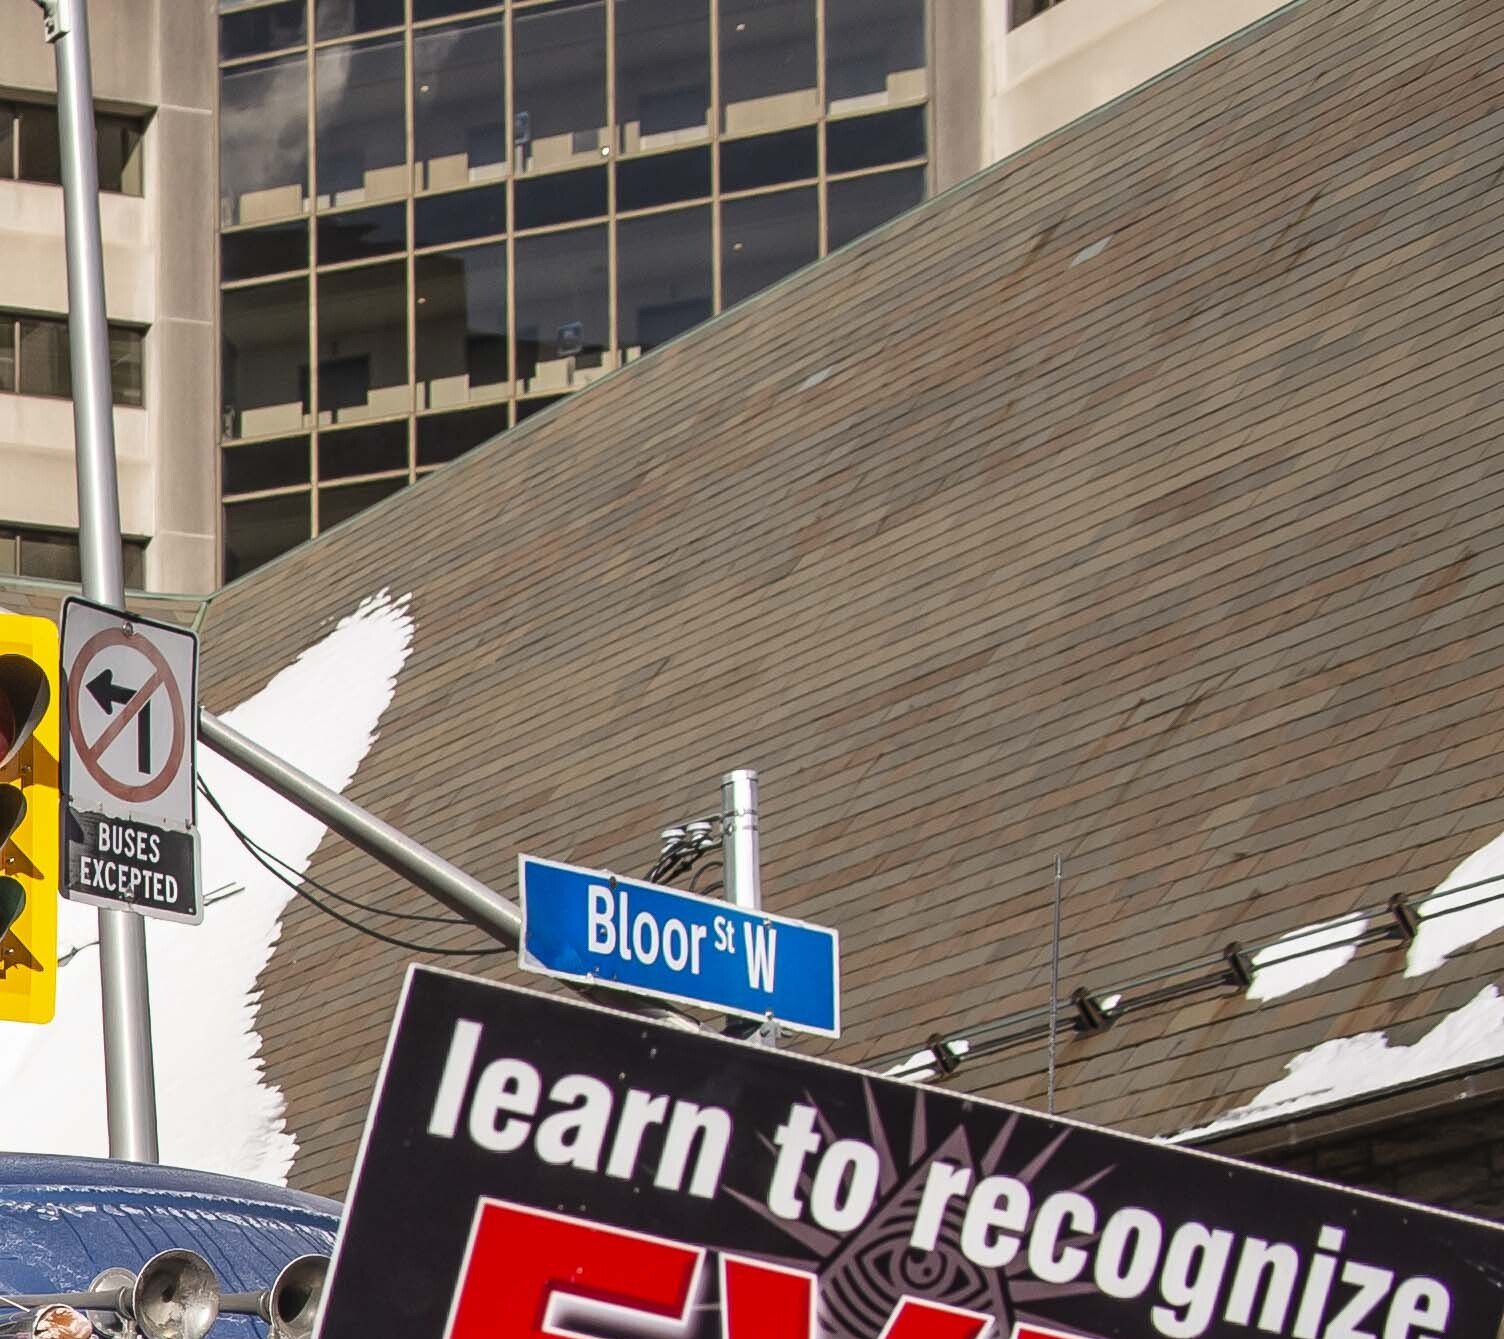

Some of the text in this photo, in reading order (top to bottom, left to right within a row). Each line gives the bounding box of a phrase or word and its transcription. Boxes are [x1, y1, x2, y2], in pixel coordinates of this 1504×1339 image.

[80, 855, 178, 904] EXCEPTED
[98, 822, 161, 864] BUSES
[588, 884, 778, 993] Bloor St W
[427, 1018, 733, 1200] learn
[767, 1102, 881, 1233] to
